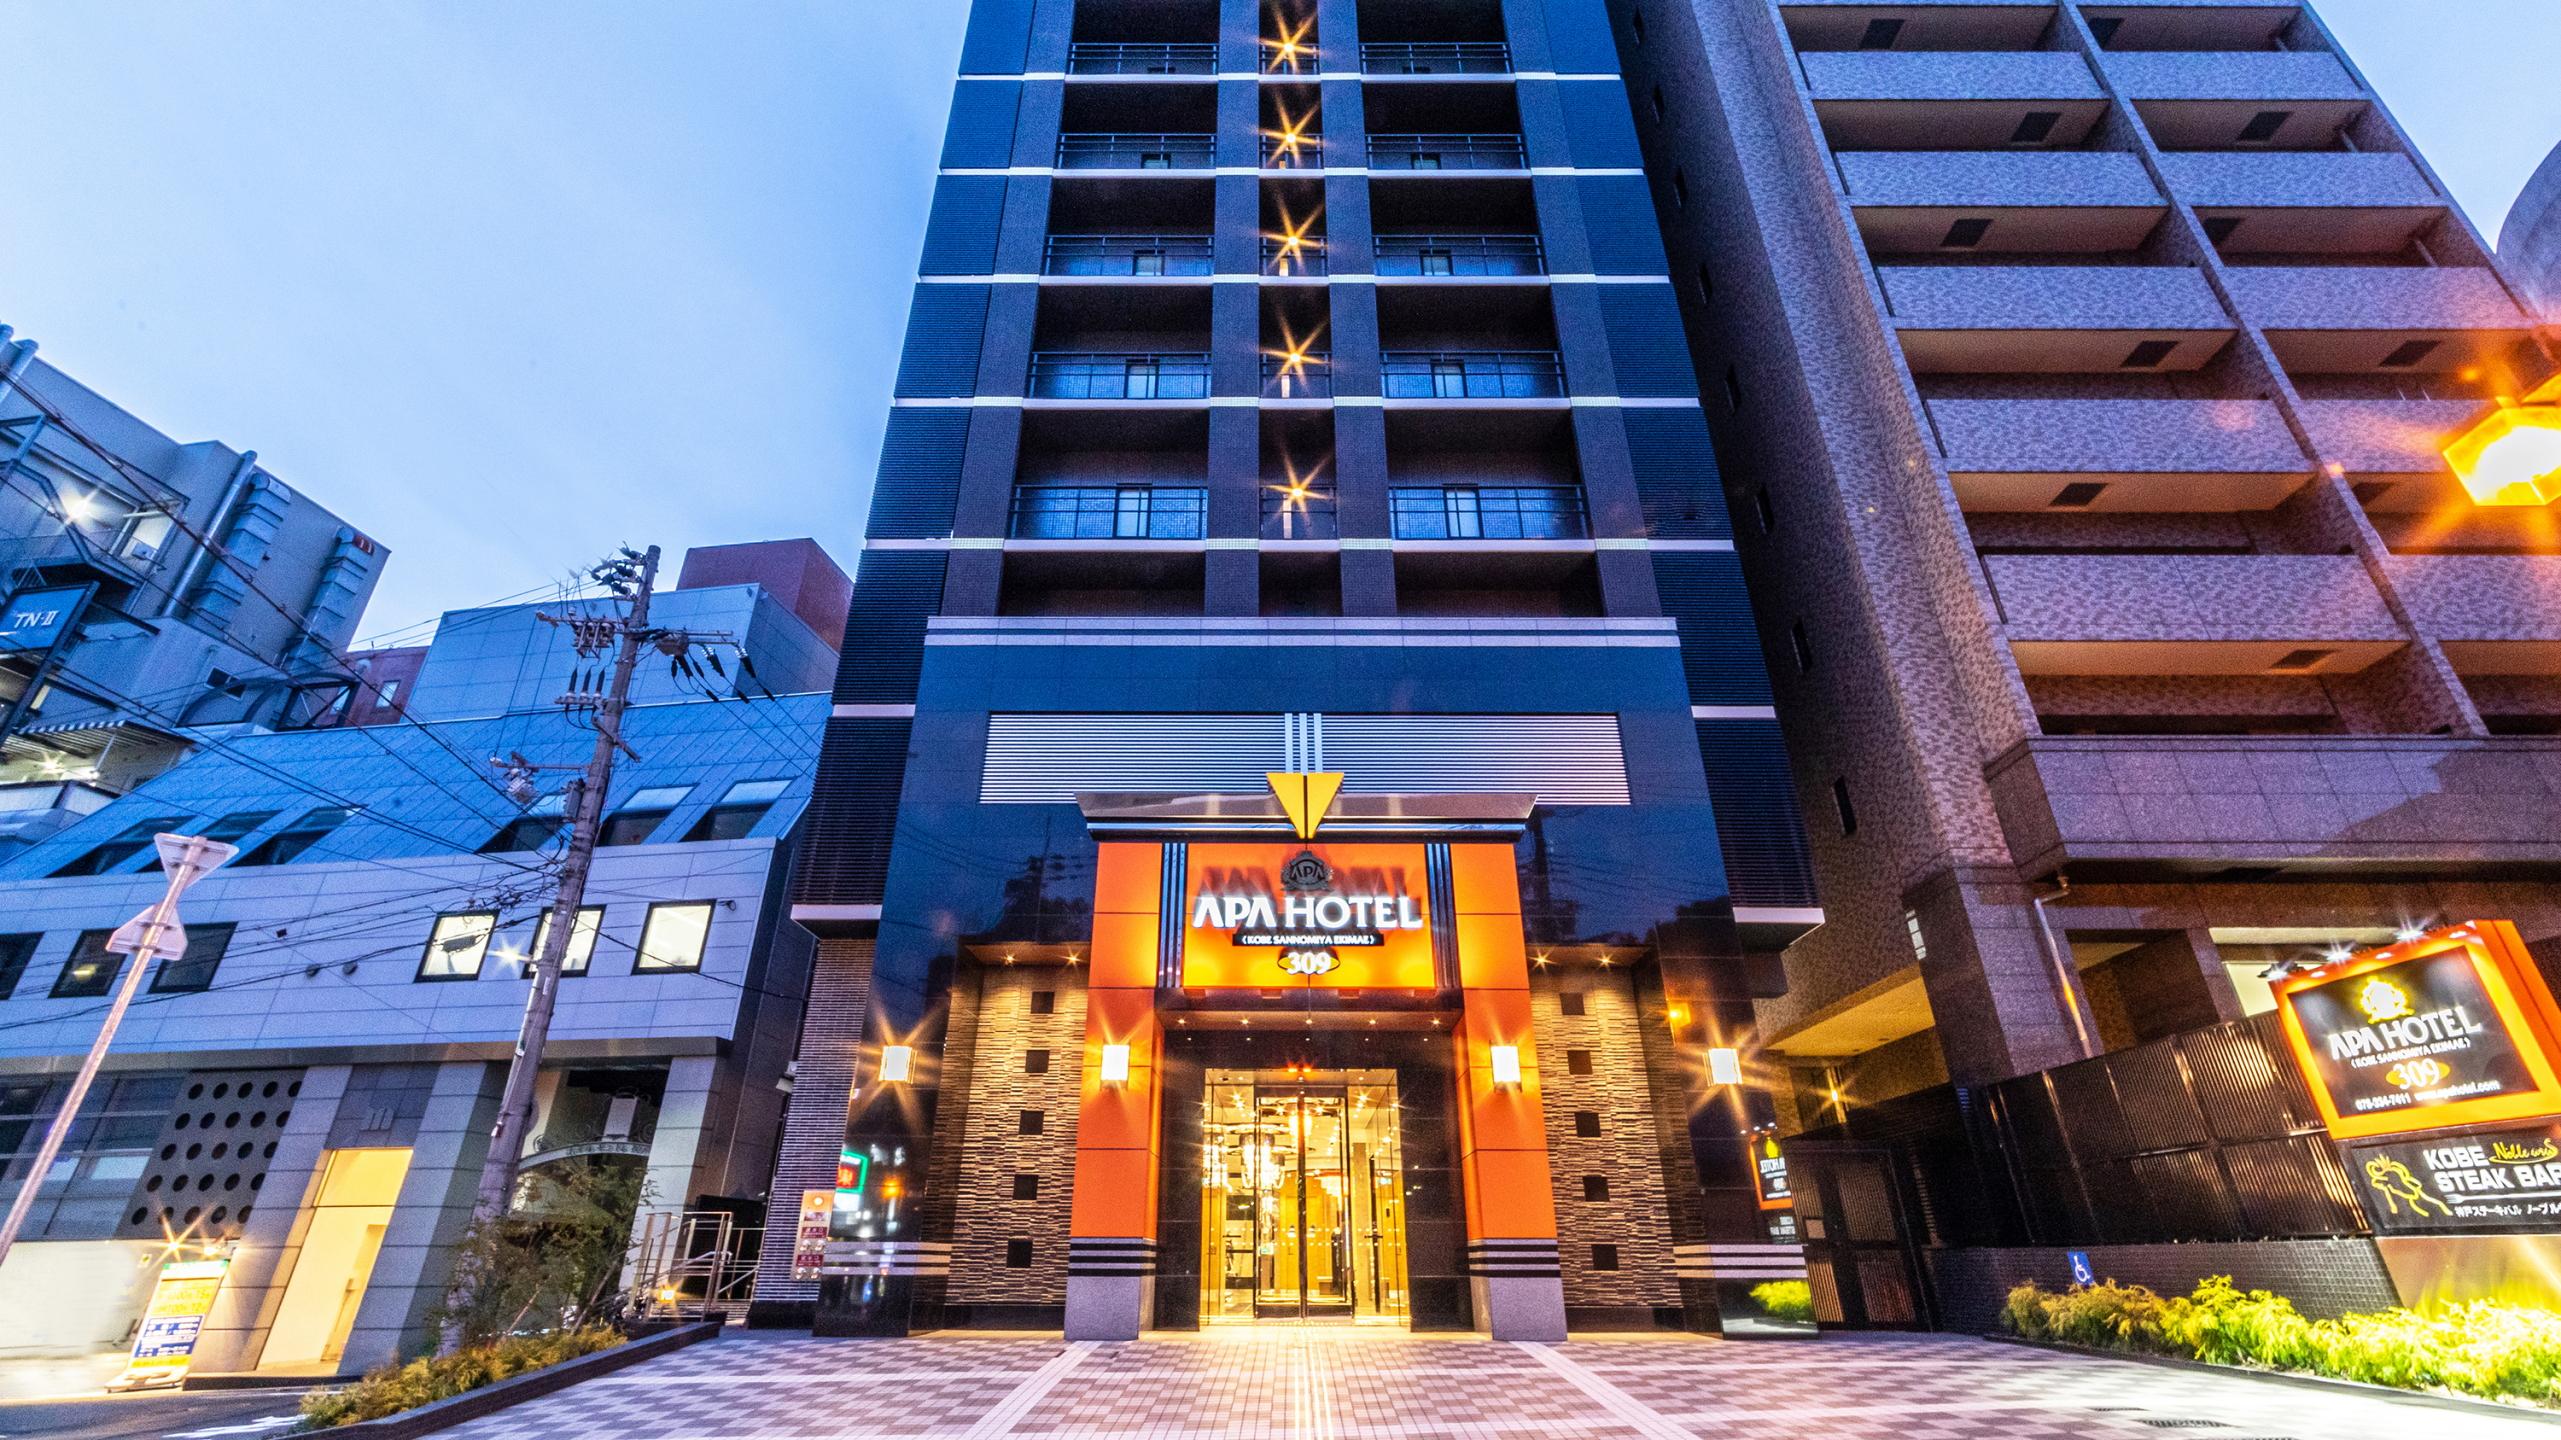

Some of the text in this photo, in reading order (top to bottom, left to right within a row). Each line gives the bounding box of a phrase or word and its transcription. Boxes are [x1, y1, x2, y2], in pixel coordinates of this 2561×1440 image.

[1191, 895, 1424, 929] APA HOTEL
[1273, 933, 1333, 945] SANNOMIYA
[1286, 950, 1333, 975] 309
[2328, 1005, 2483, 1061] APA HOTEL
[2376, 1045, 2432, 1064] SANNOMIYA
[2393, 1057, 2441, 1090] 309
[2422, 1145, 2491, 1171] KOBE
[2434, 1161, 2561, 1193] STEAK BAR
[2526, 1201, 2561, 1215] ノーブル
